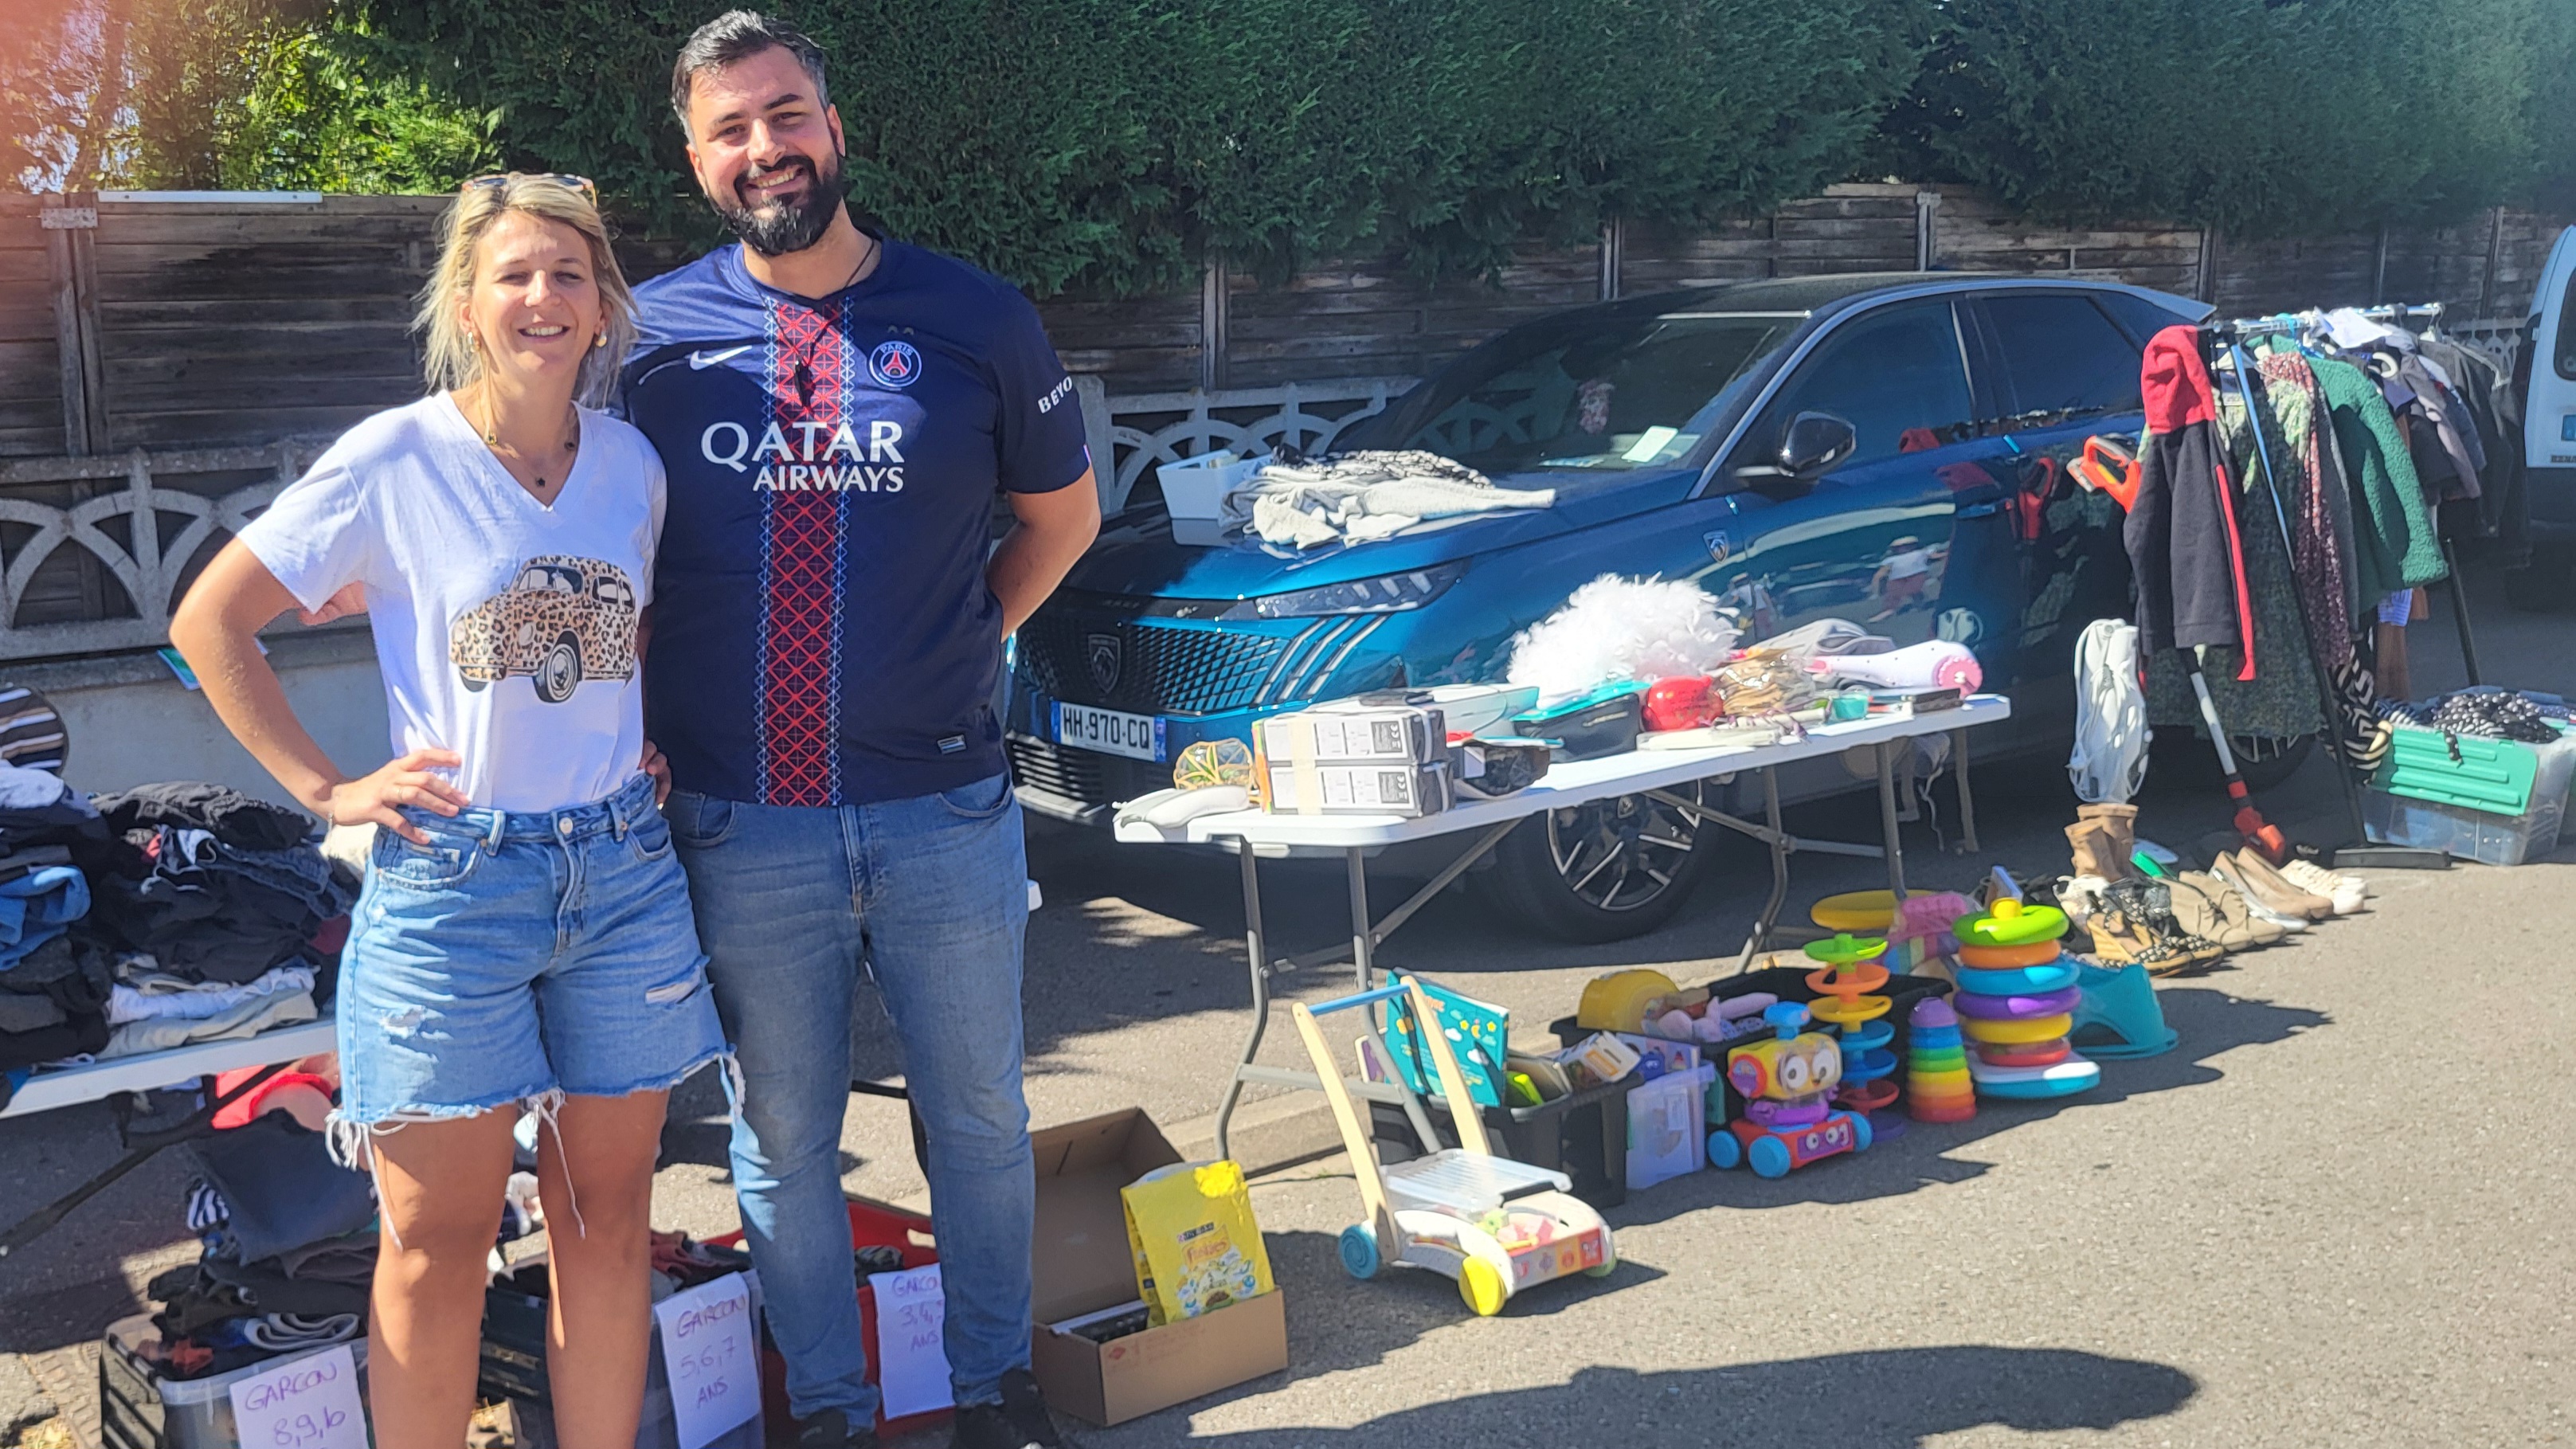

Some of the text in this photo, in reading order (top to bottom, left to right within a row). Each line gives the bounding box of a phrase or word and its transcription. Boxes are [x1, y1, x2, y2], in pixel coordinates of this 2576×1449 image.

[879, 344, 914, 356] PARIS
[701, 421, 905, 472] QATAR
[753, 465, 904, 492] AIRWAYS
[892, 1275, 939, 1297] GARCO
[910, 1330, 939, 1352] ANS
[697, 1376, 728, 1409] ANS
